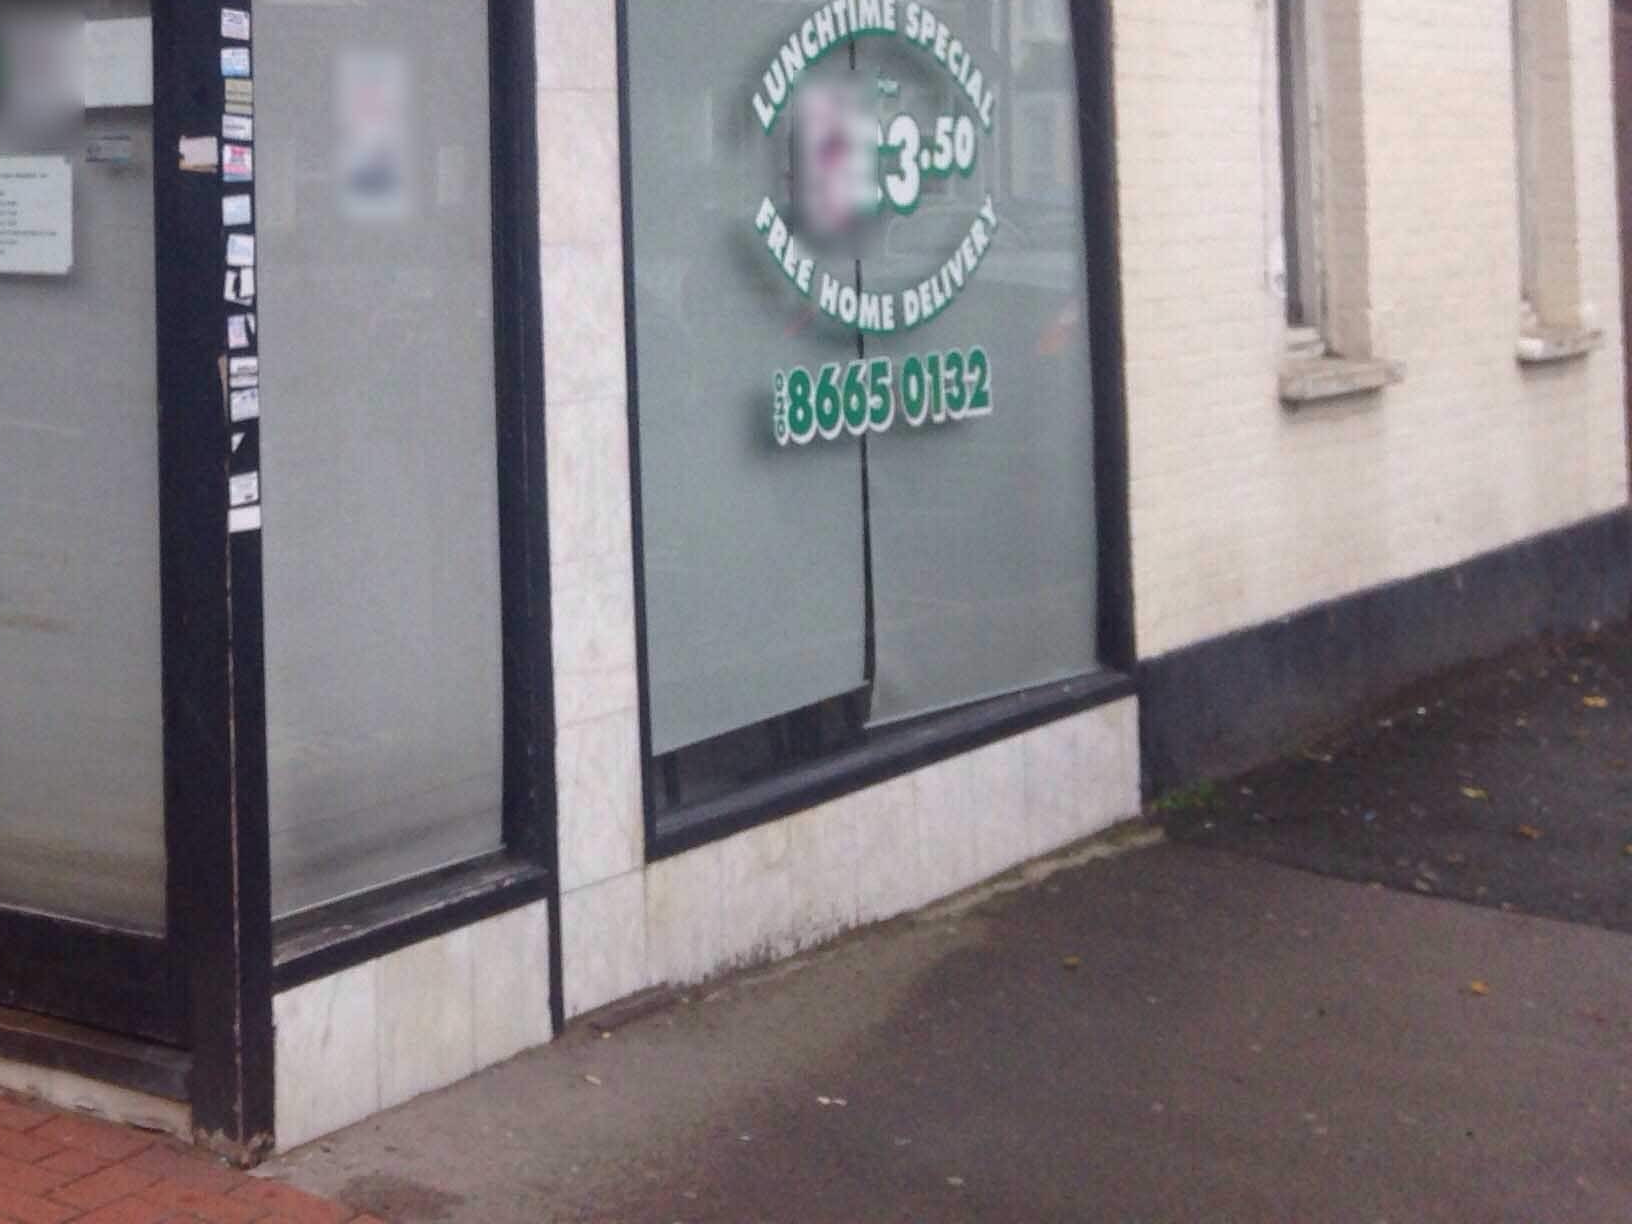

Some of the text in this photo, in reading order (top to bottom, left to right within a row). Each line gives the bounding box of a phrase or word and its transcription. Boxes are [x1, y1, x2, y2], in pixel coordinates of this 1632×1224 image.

[905, 1, 993, 131] SPECIAL
[876, 114, 976, 215] 3.50
[755, 193, 999, 334] FREE HOME DELIVERY
[786, 356, 895, 444] 8665
[900, 343, 993, 428] 0132
